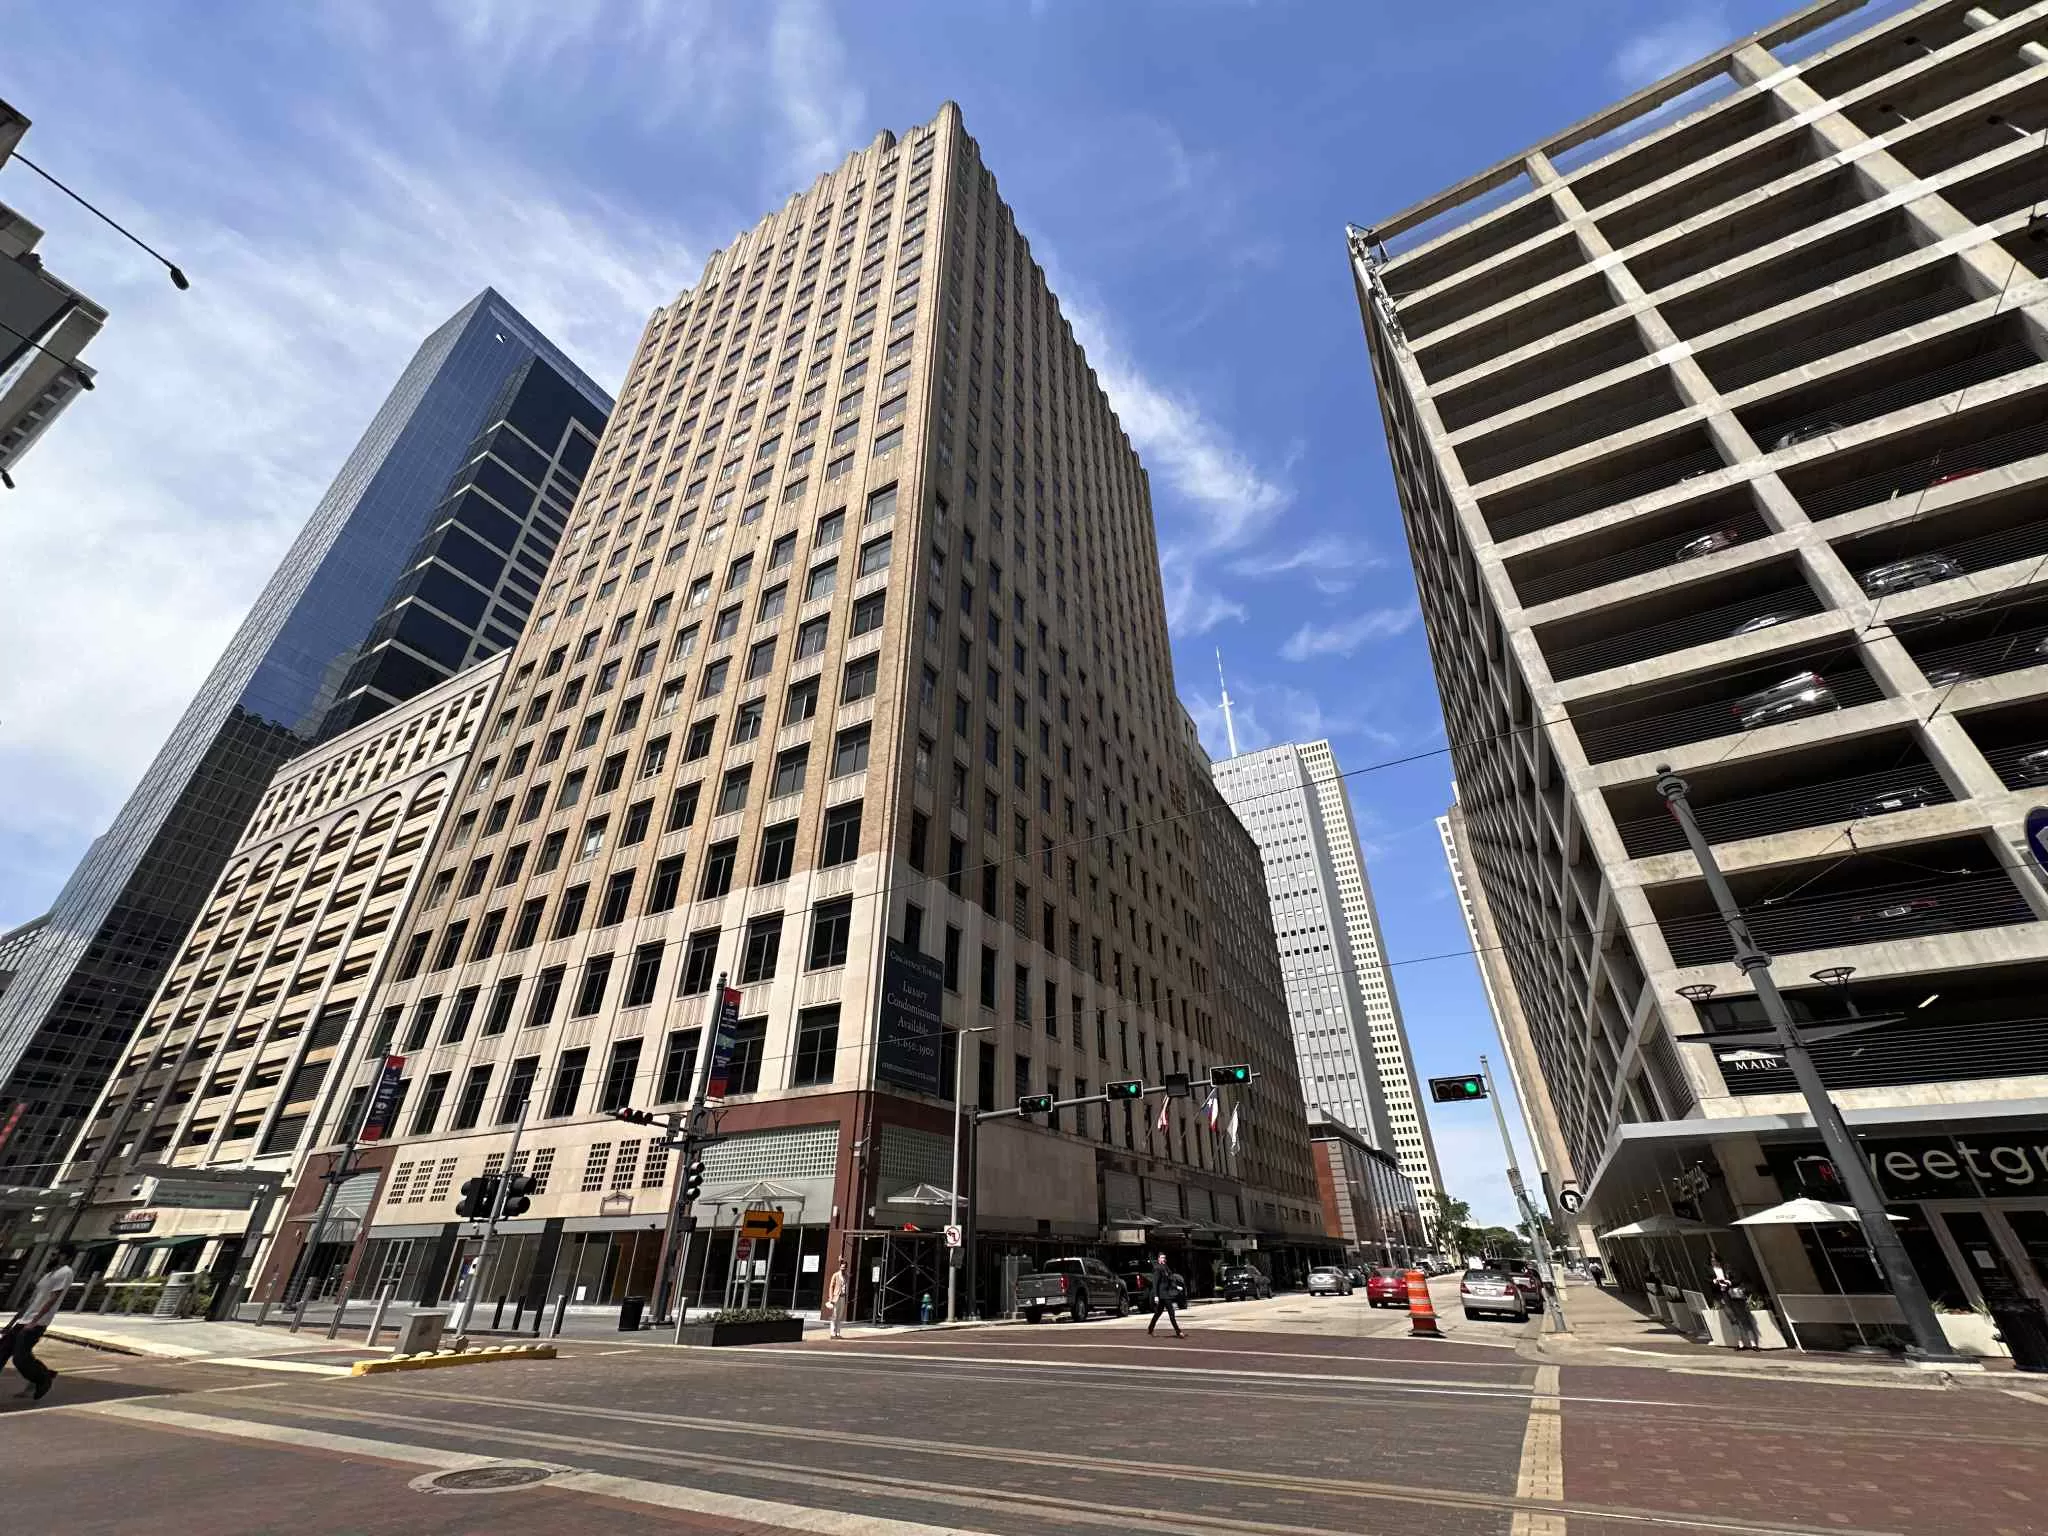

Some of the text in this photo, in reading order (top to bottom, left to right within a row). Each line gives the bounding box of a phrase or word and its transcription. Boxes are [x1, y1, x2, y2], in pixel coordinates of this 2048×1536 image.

[887, 992, 940, 1023] Condominiums
[897, 1015, 929, 1035] Available
[1735, 1058, 1778, 1071] MAIN
